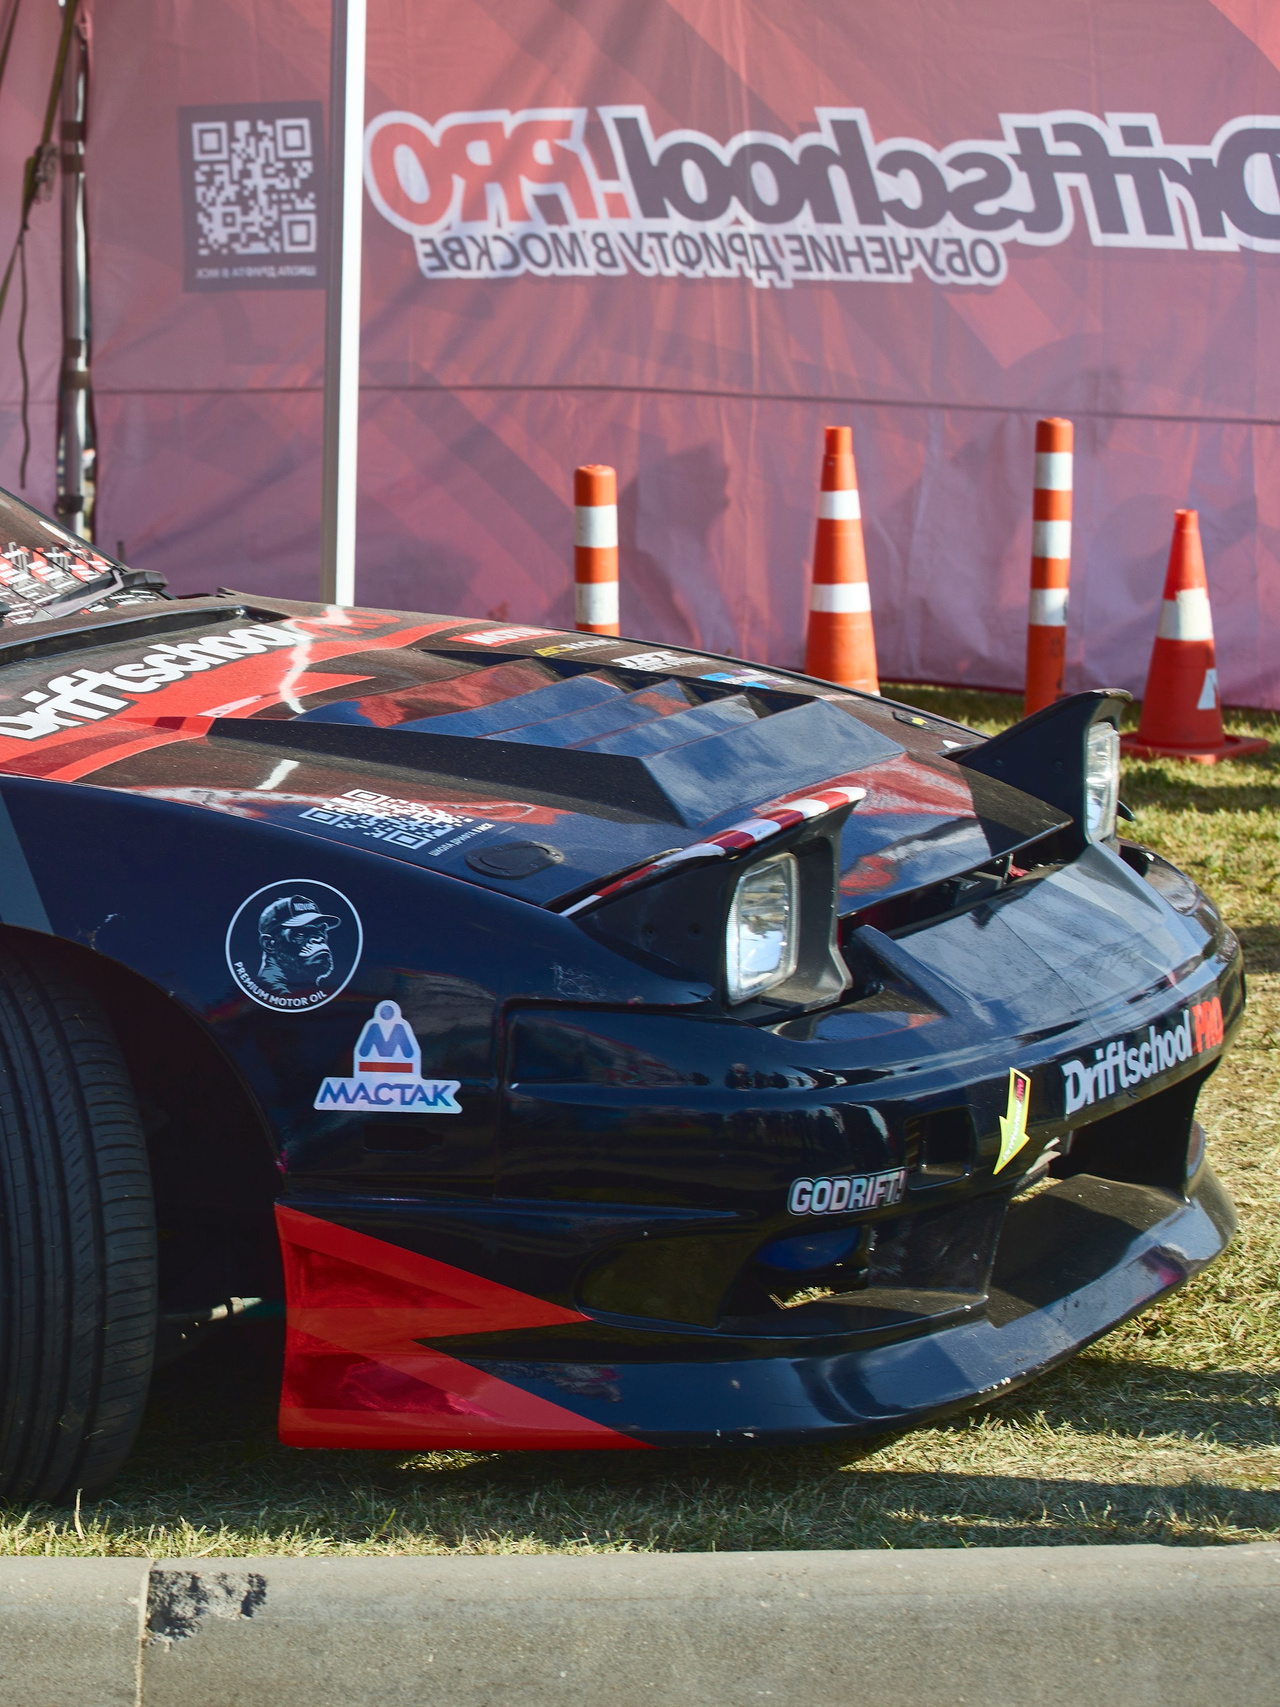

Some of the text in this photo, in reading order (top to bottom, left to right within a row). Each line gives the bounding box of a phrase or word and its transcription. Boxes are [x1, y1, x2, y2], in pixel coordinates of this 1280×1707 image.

[293, 902, 317, 912] NOVUS
[233, 961, 328, 1008] PREMIUM MOTOR OIL
[790, 1168, 905, 1214] GODRIFT!
